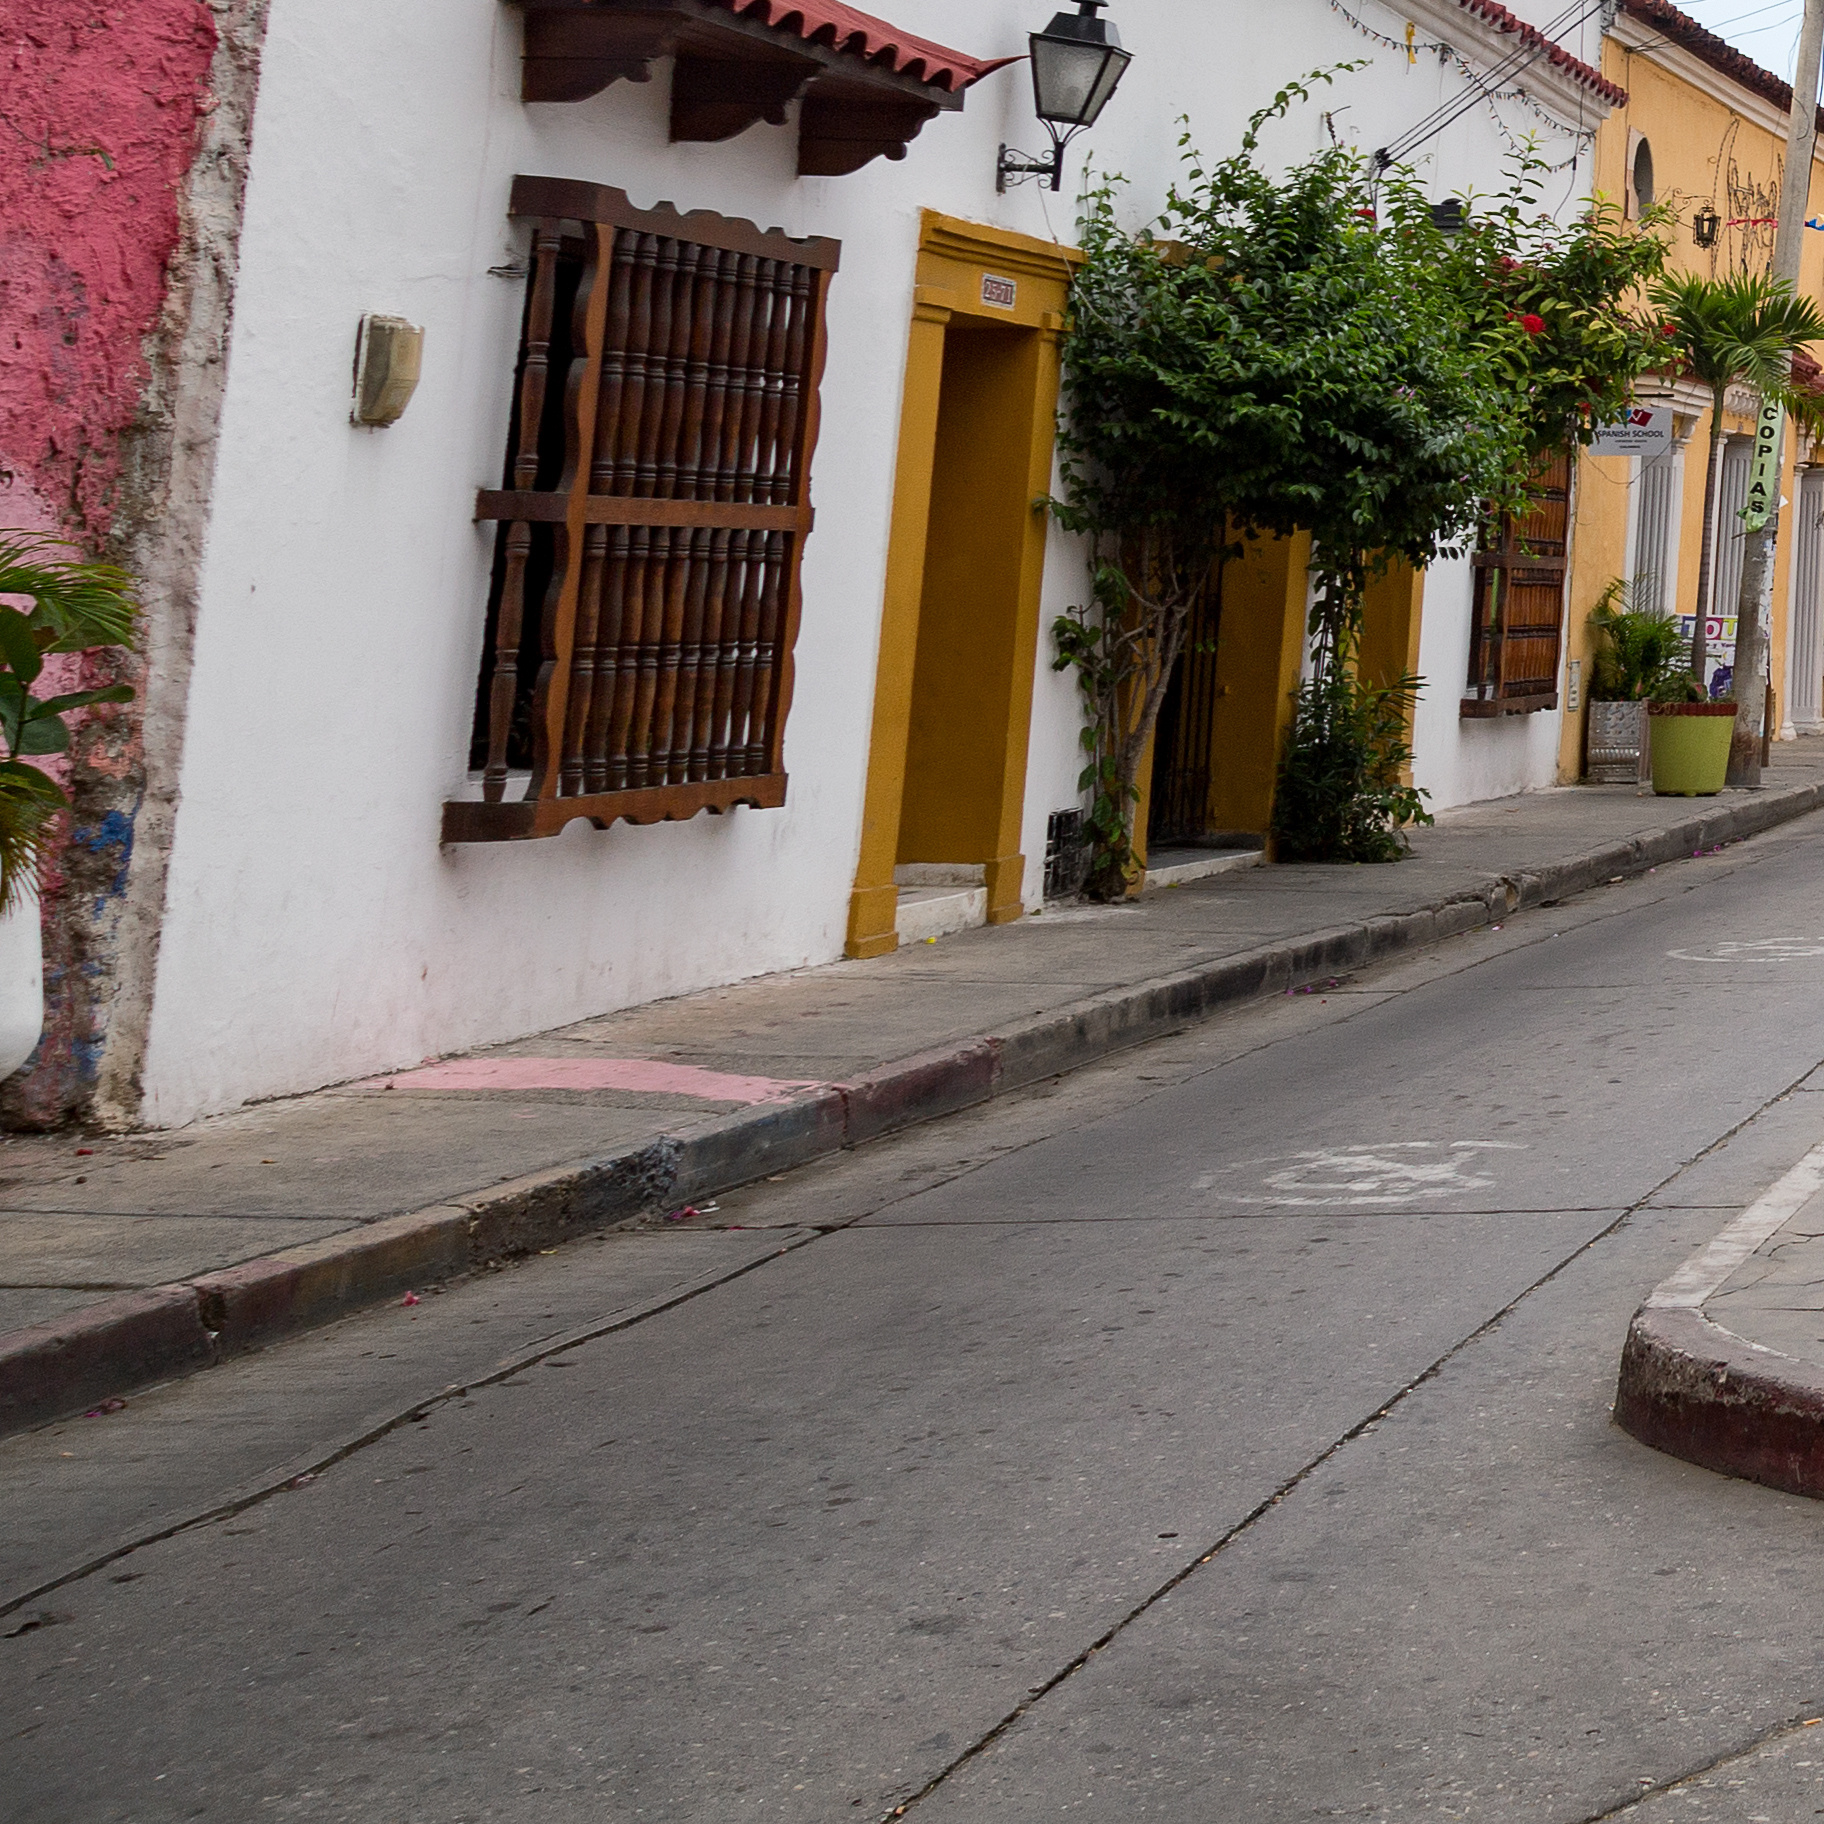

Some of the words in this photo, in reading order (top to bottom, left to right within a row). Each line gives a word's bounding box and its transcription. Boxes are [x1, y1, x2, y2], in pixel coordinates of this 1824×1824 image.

[1598, 430, 1630, 438] SPANISH
[1632, 430, 1664, 438] SCHOOL
[1750, 407, 1778, 514] COPIAS
